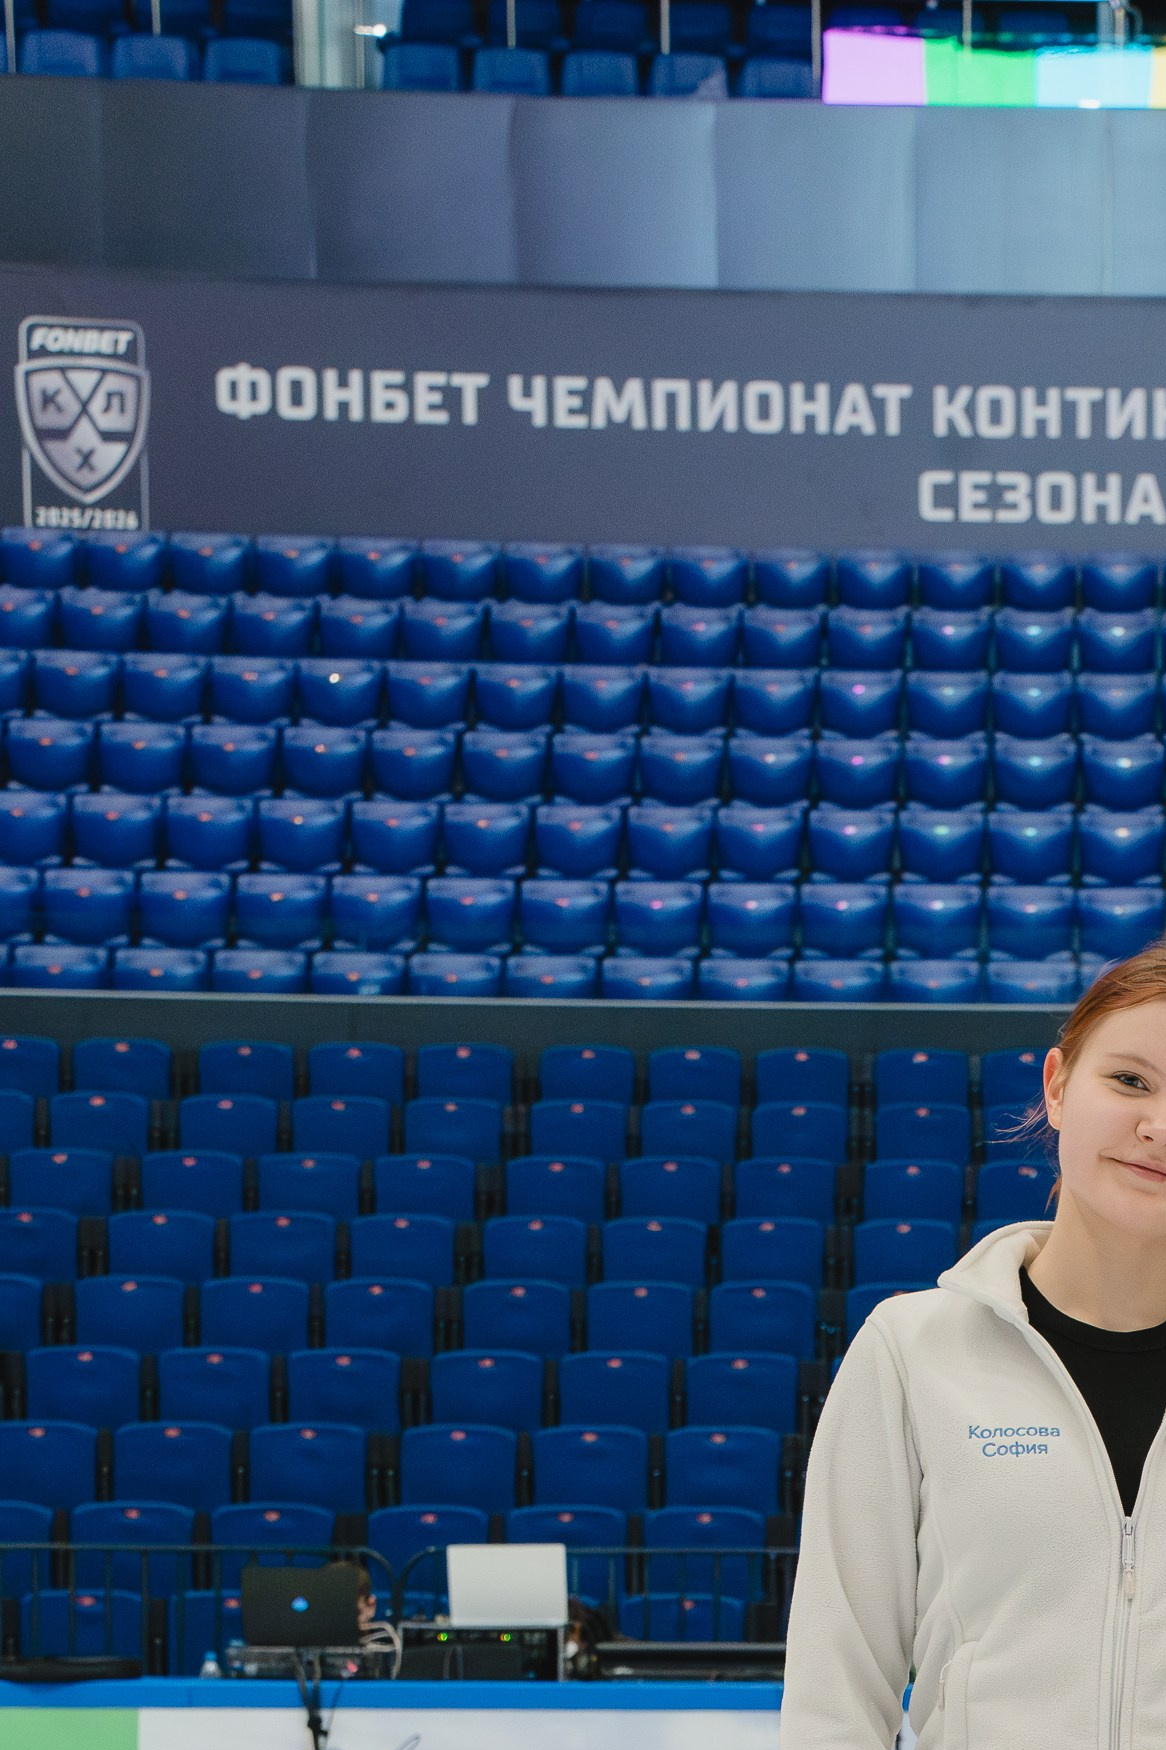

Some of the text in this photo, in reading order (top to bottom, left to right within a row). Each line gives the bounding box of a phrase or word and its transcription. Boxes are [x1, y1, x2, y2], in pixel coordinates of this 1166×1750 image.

[30, 326, 135, 355] FONBET
[214, 362, 490, 425] ФОНБЕТ
[506, 374, 912, 437] ЧЕМПИОНАТ
[968, 1425, 1061, 1440] Колосова
[982, 1441, 1048, 1457] София
